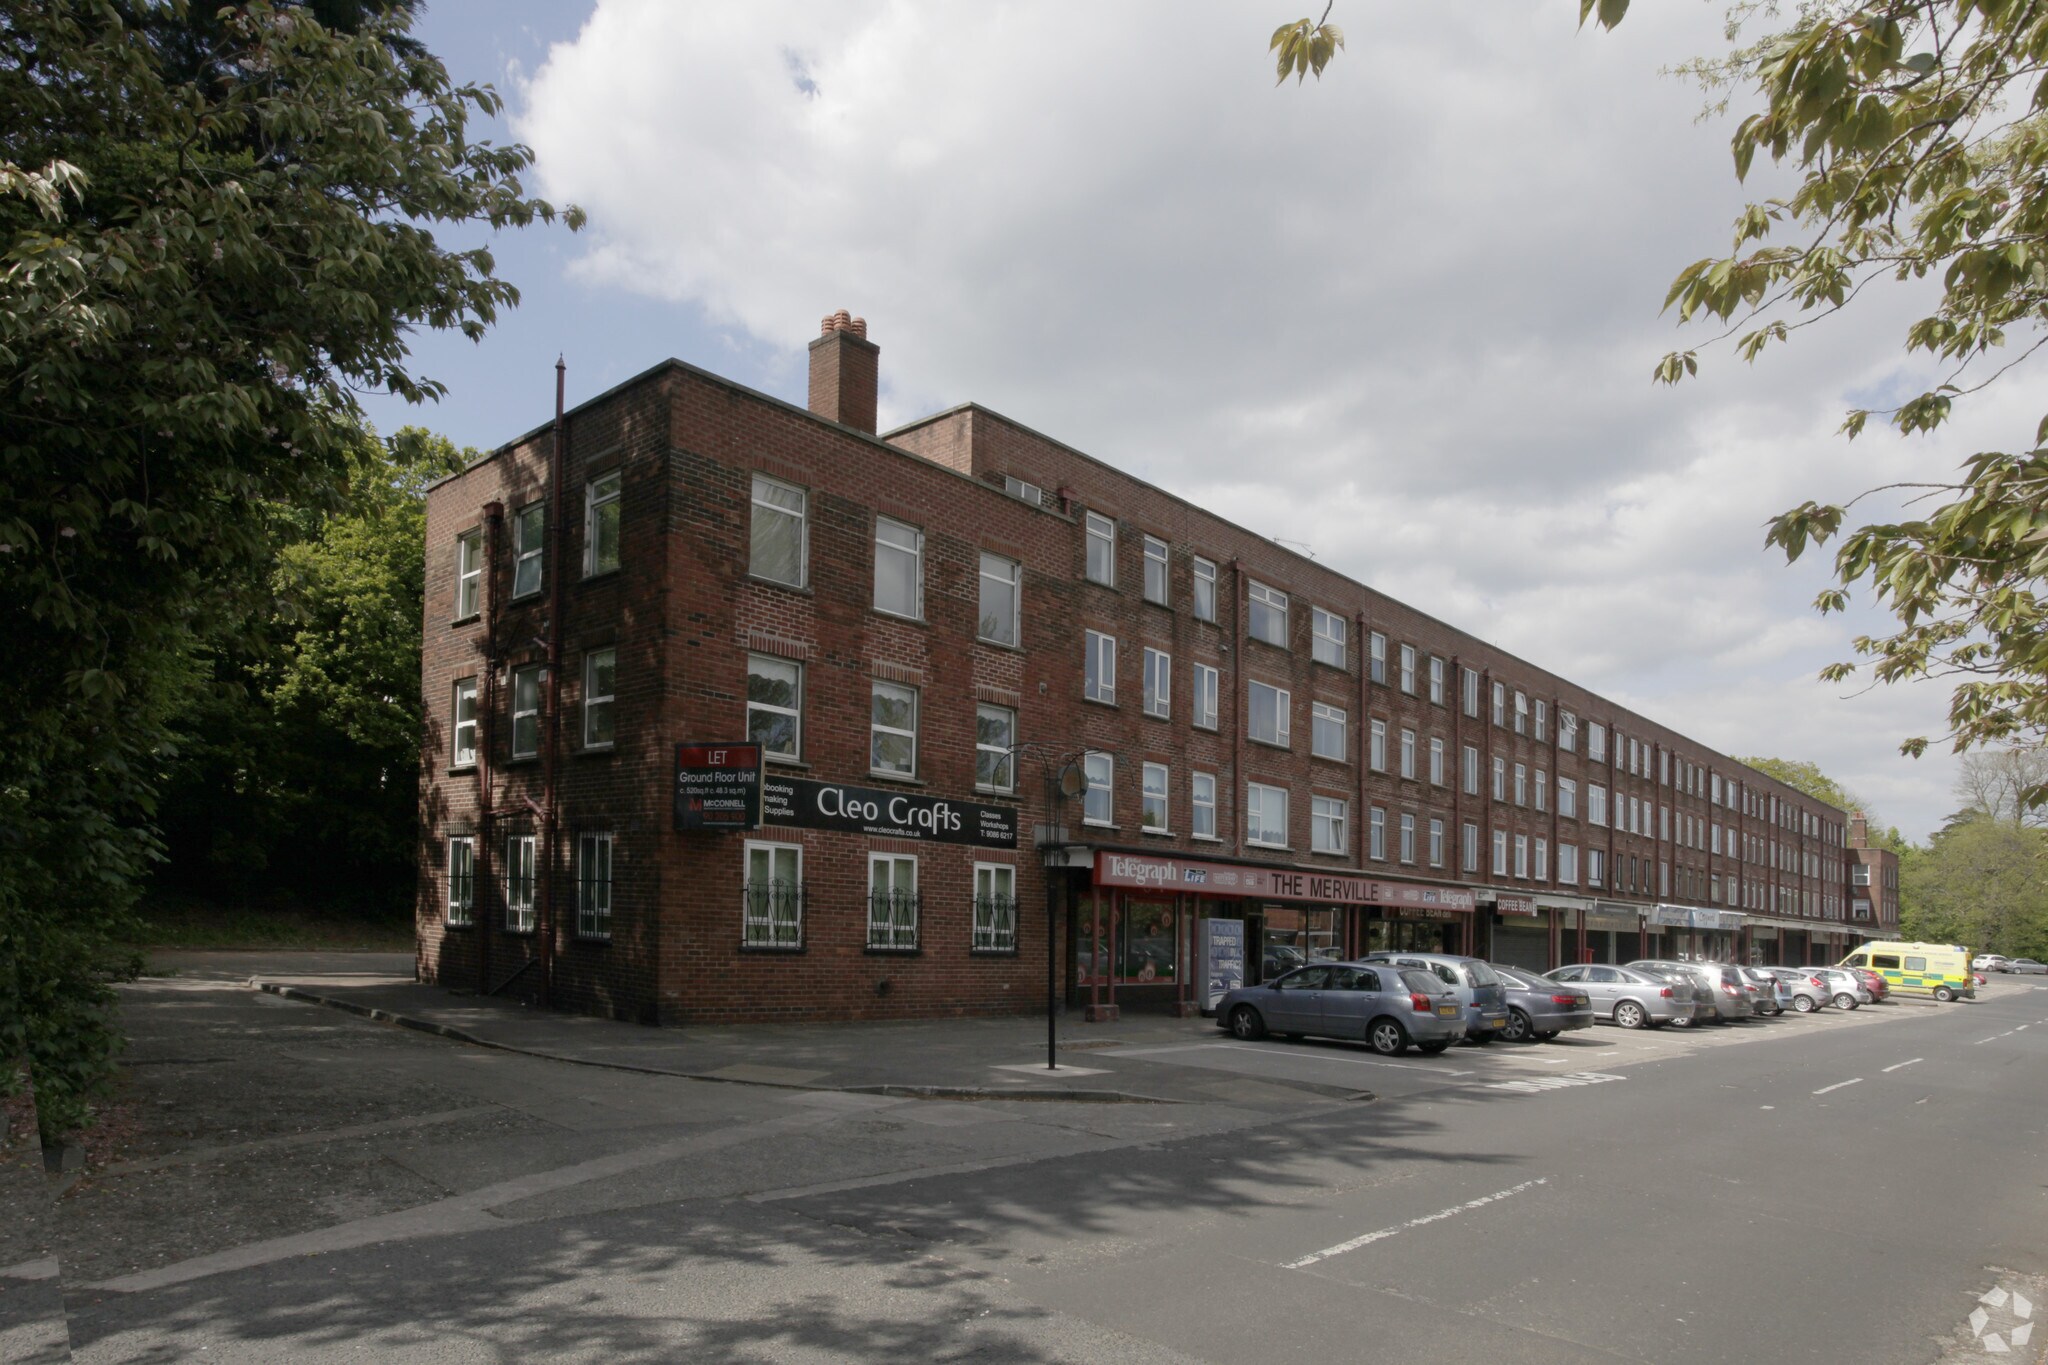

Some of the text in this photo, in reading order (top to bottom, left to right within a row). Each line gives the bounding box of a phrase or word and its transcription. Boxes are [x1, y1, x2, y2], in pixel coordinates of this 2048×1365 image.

[708, 750, 728, 764] LET
[679, 771, 756, 783] Ground Floor Unit
[763, 783, 793, 796] booking
[703, 799, 746, 808] McCONNELL
[764, 805, 795, 817] Supplies
[817, 787, 961, 835] Cleo Crafts
[980, 810, 1002, 820] Classes
[863, 825, 921, 838] www.cleocrafts.co.uk
[980, 820, 1009, 831] Workshops
[986, 830, 1000, 839] 9086
[1108, 856, 1177, 886] Telegraph
[1271, 873, 1303, 896] THE
[1310, 877, 1379, 902] MERVILLE
[1439, 889, 1473, 909] Telegraph
[1497, 898, 1518, 912] COFFEE
[1519, 900, 1533, 912] BEAN
